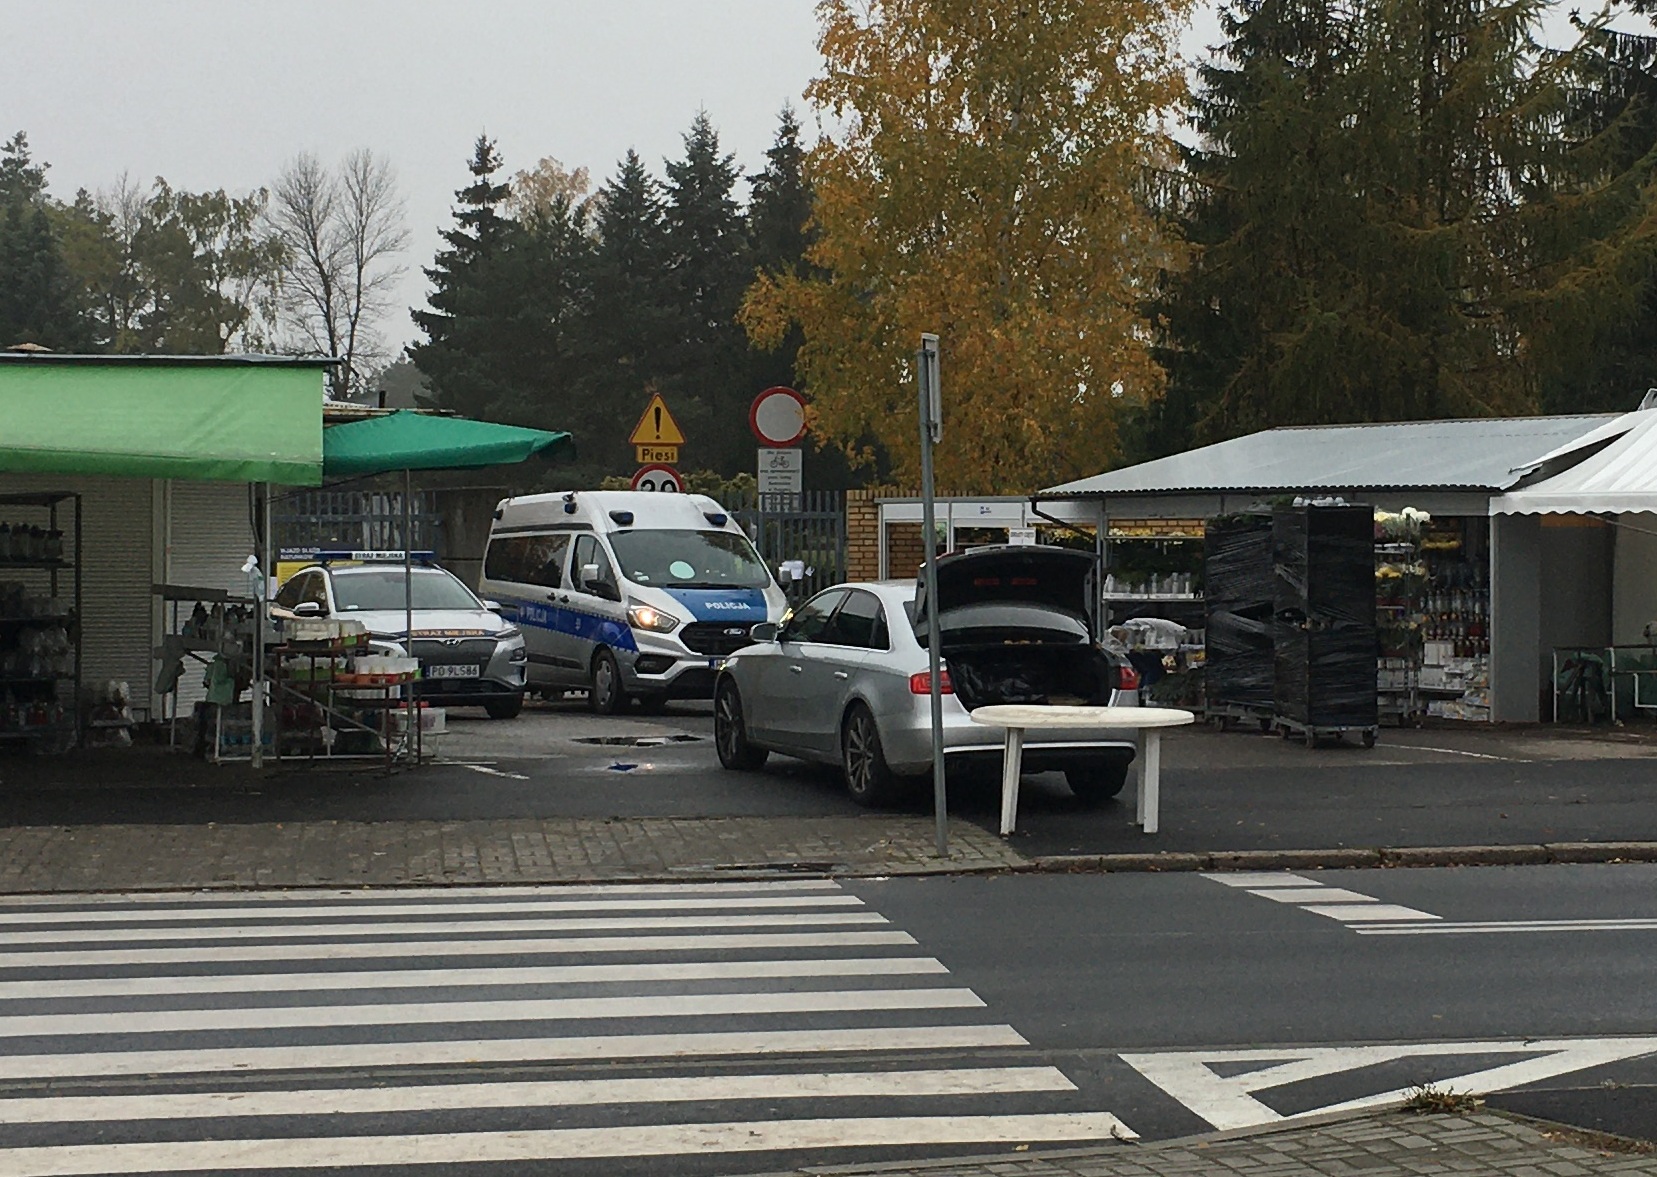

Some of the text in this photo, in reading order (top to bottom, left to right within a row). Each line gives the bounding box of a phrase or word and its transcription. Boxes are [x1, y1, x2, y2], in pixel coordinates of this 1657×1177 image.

[641, 448, 675, 461] Piesi
[705, 602, 751, 610] POLICJA
[431, 666, 445, 677] PO
